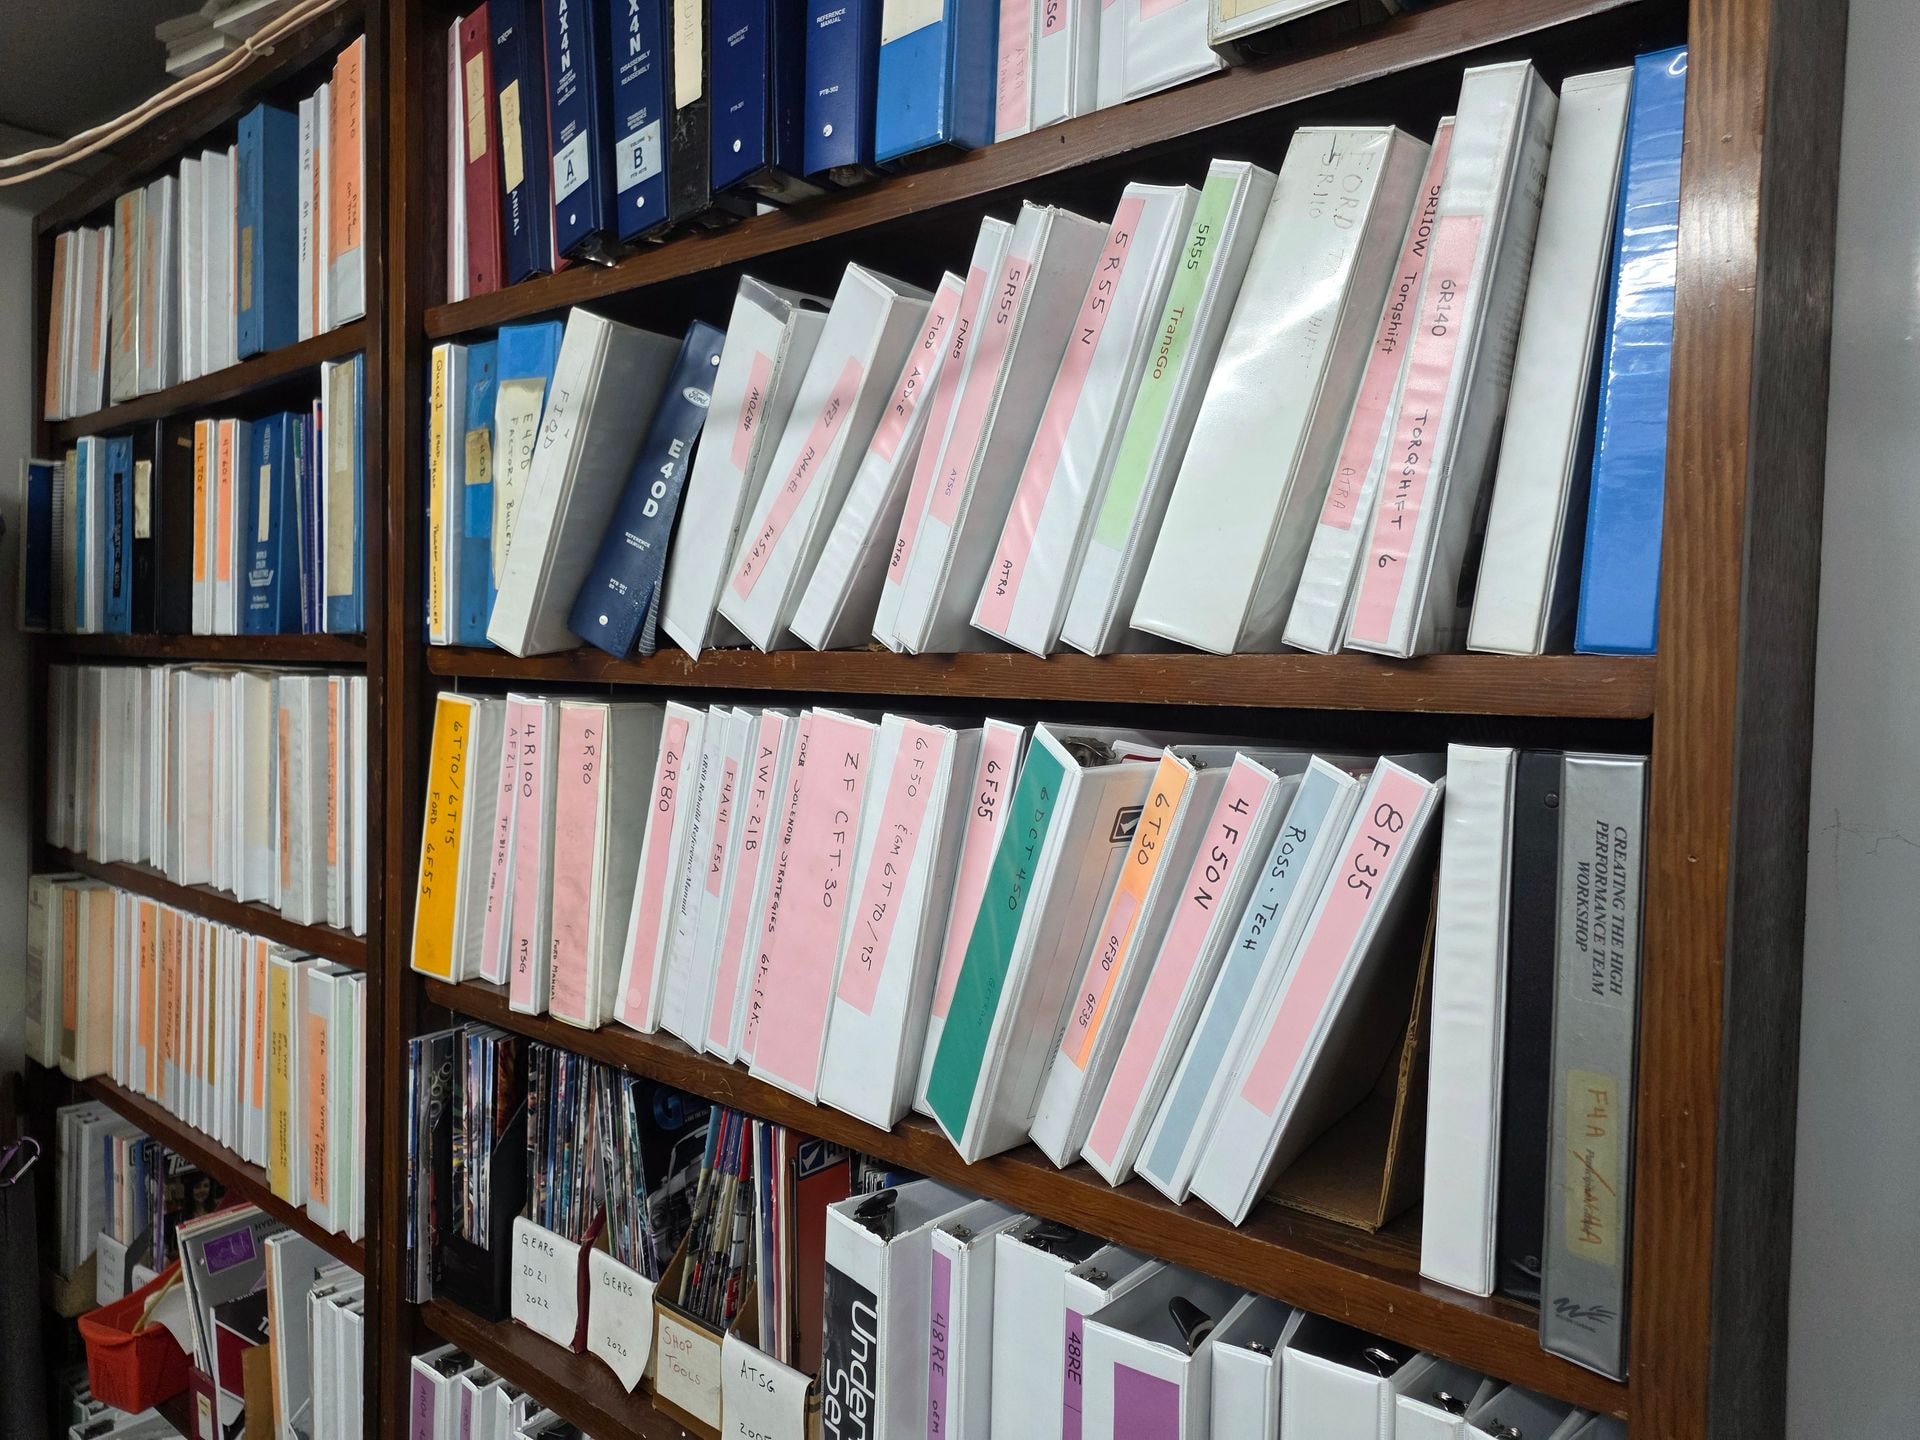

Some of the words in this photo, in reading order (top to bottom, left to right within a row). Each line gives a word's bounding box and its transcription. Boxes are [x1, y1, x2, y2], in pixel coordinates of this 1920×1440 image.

[816, 8, 846, 24] REFERENCE
[820, 16, 842, 28] MANUAL
[1046, 0, 1058, 28] SG
[566, 160, 574, 181] A
[634, 146, 644, 170] B
[1334, 151, 1376, 230] FORD
[512, 190, 520, 236] ANUAL
[1413, 185, 1441, 258] 5R110W
[1188, 224, 1210, 270] 5R55
[997, 268, 1020, 325] 5R55
[1382, 272, 1418, 354] Torqshift
[1432, 280, 1457, 338] 6R140
[952, 318, 968, 360] FNR5
[1152, 307, 1184, 380] TransGo
[688, 388, 710, 406] Ford
[506, 417, 518, 487] FACTORY
[1391, 410, 1428, 530] TORQSHIFT
[944, 468, 958, 497] ATSG
[1333, 468, 1356, 510] ATRA
[625, 532, 651, 548] REFERENCE
[626, 538, 645, 552] MANUAL
[892, 538, 906, 568] ATRA
[996, 560, 1012, 596] ATRA
[1378, 554, 1397, 568] 6
[523, 724, 537, 798] 4R100
[582, 728, 595, 786] 6R80
[908, 738, 928, 798] 6F50
[658, 750, 678, 812] 6R80
[694, 781, 704, 822] Rebuild
[718, 771, 734, 823] F4A41
[978, 760, 1001, 822] 6F35
[430, 792, 440, 825] FORD
[1138, 792, 1170, 865] 6T30
[686, 822, 700, 874] Reference
[712, 844, 722, 874] F5A
[890, 835, 906, 856] GM
[1348, 804, 1404, 900] 8F35
[1593, 820, 1610, 944] PERFORMANCE
[1612, 826, 1628, 910] CREATING
[680, 875, 692, 916] Manual
[768, 850, 787, 934] STRATEGIES
[1576, 861, 1590, 952] WORKSHOP
[1610, 912, 1624, 950] THE
[520, 938, 528, 974] ATSG
[1102, 936, 1120, 972] 6F30
[1592, 950, 1606, 998] TEAM
[1609, 952, 1624, 996] HIGH
[1078, 993, 1096, 1028] 6F35
[522, 1234, 554, 1258] GEARS
[522, 1264, 548, 1284] 2021
[602, 1272, 633, 1297] GEARS
[526, 1293, 550, 1310] 2022
[606, 1336, 628, 1356] 2020
[662, 1326, 693, 1353] SHOP
[932, 1312, 946, 1376] 48RE
[1066, 1330, 1082, 1386] 48RE
[665, 1354, 701, 1386] TOOLS
[740, 1360, 777, 1393] ATSG
[848, 1300, 878, 1440] Under
[932, 1400, 940, 1433] OEM
